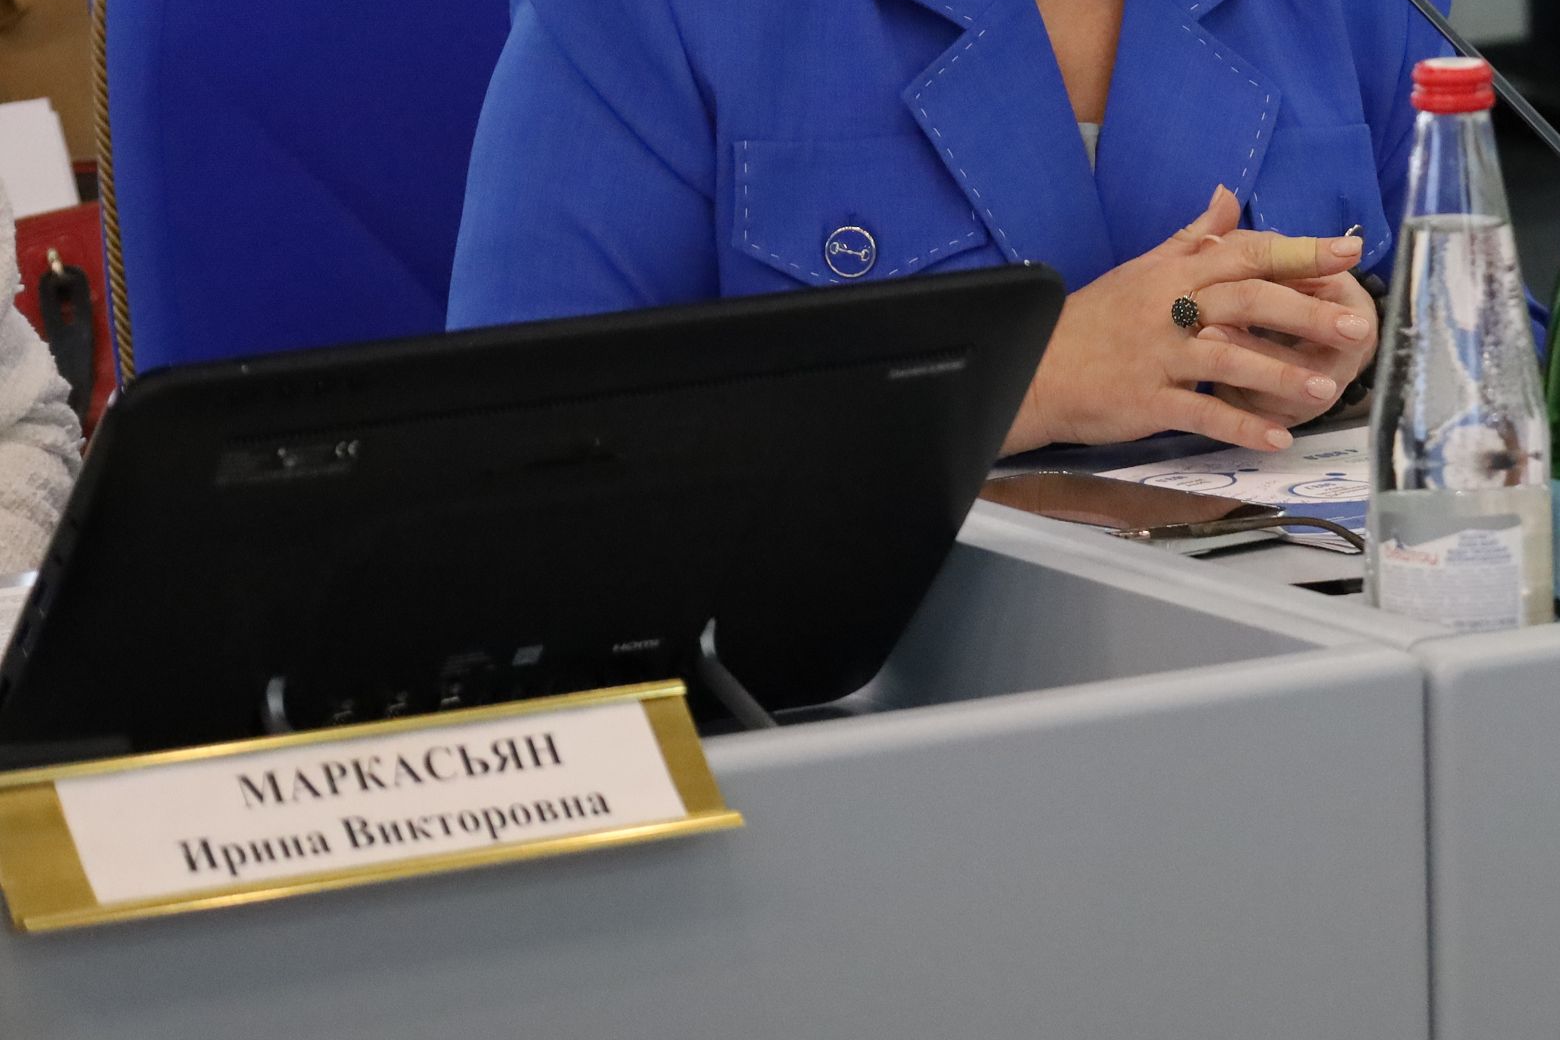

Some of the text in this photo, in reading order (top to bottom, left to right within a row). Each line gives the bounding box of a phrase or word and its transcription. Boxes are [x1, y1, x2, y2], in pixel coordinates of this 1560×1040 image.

[238, 733, 563, 809] МАРКАСЬЯН
[178, 792, 612, 879] Ирина Викторовна
